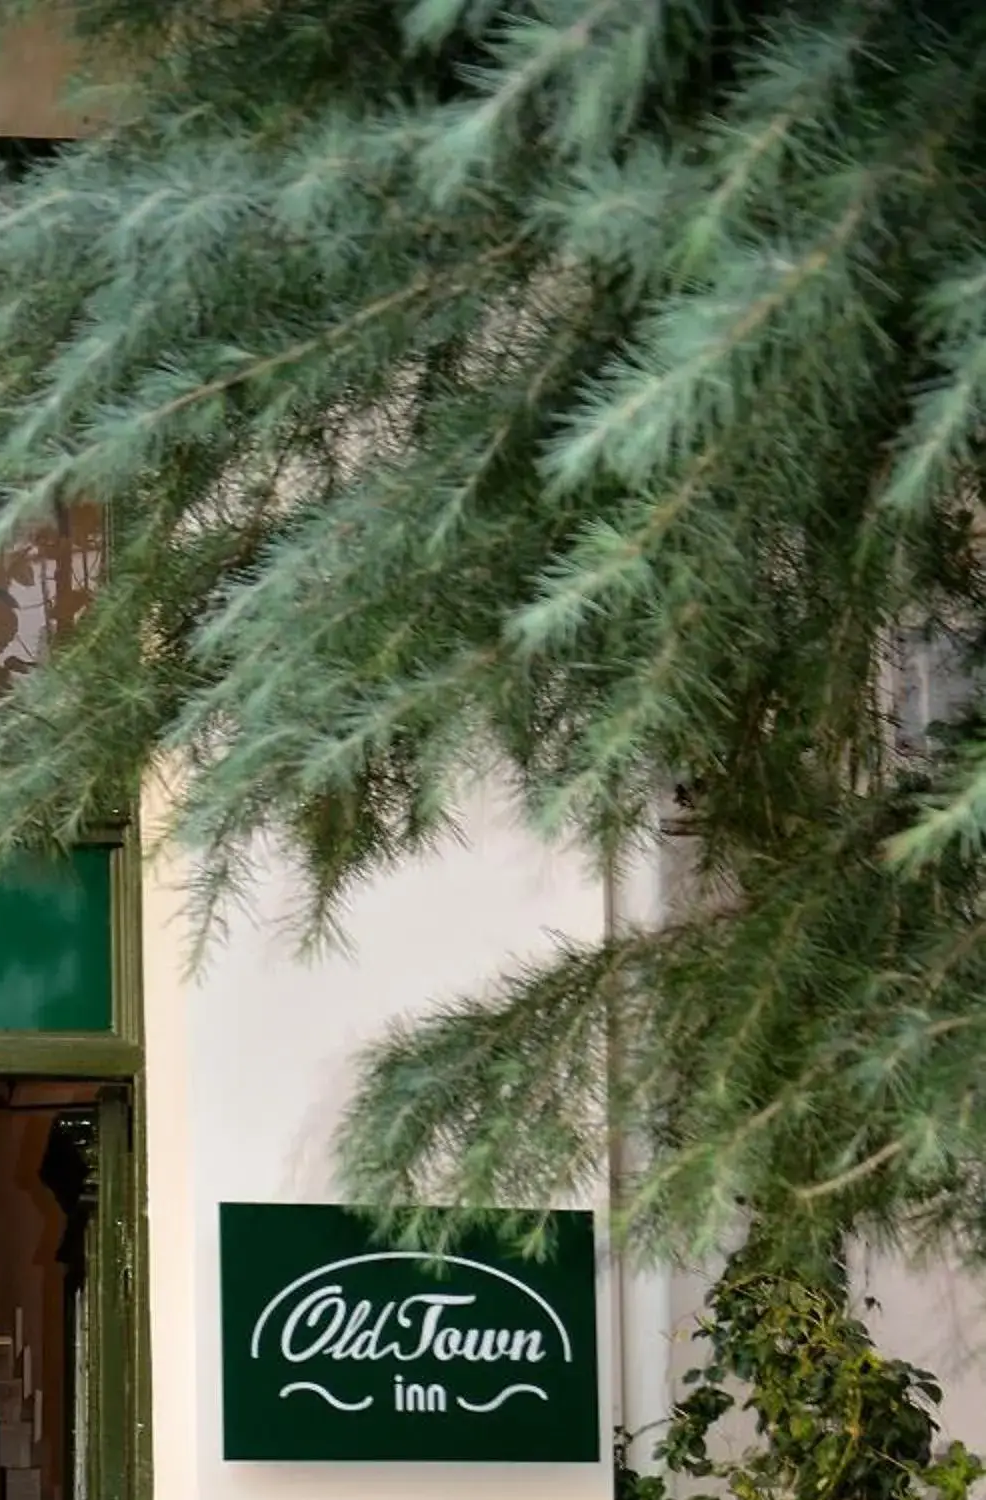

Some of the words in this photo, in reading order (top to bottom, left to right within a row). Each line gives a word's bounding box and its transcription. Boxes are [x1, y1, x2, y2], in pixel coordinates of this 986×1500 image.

[281, 1285, 399, 1362] Old
[397, 1293, 546, 1362] Town
[394, 1374, 447, 1412] inn
